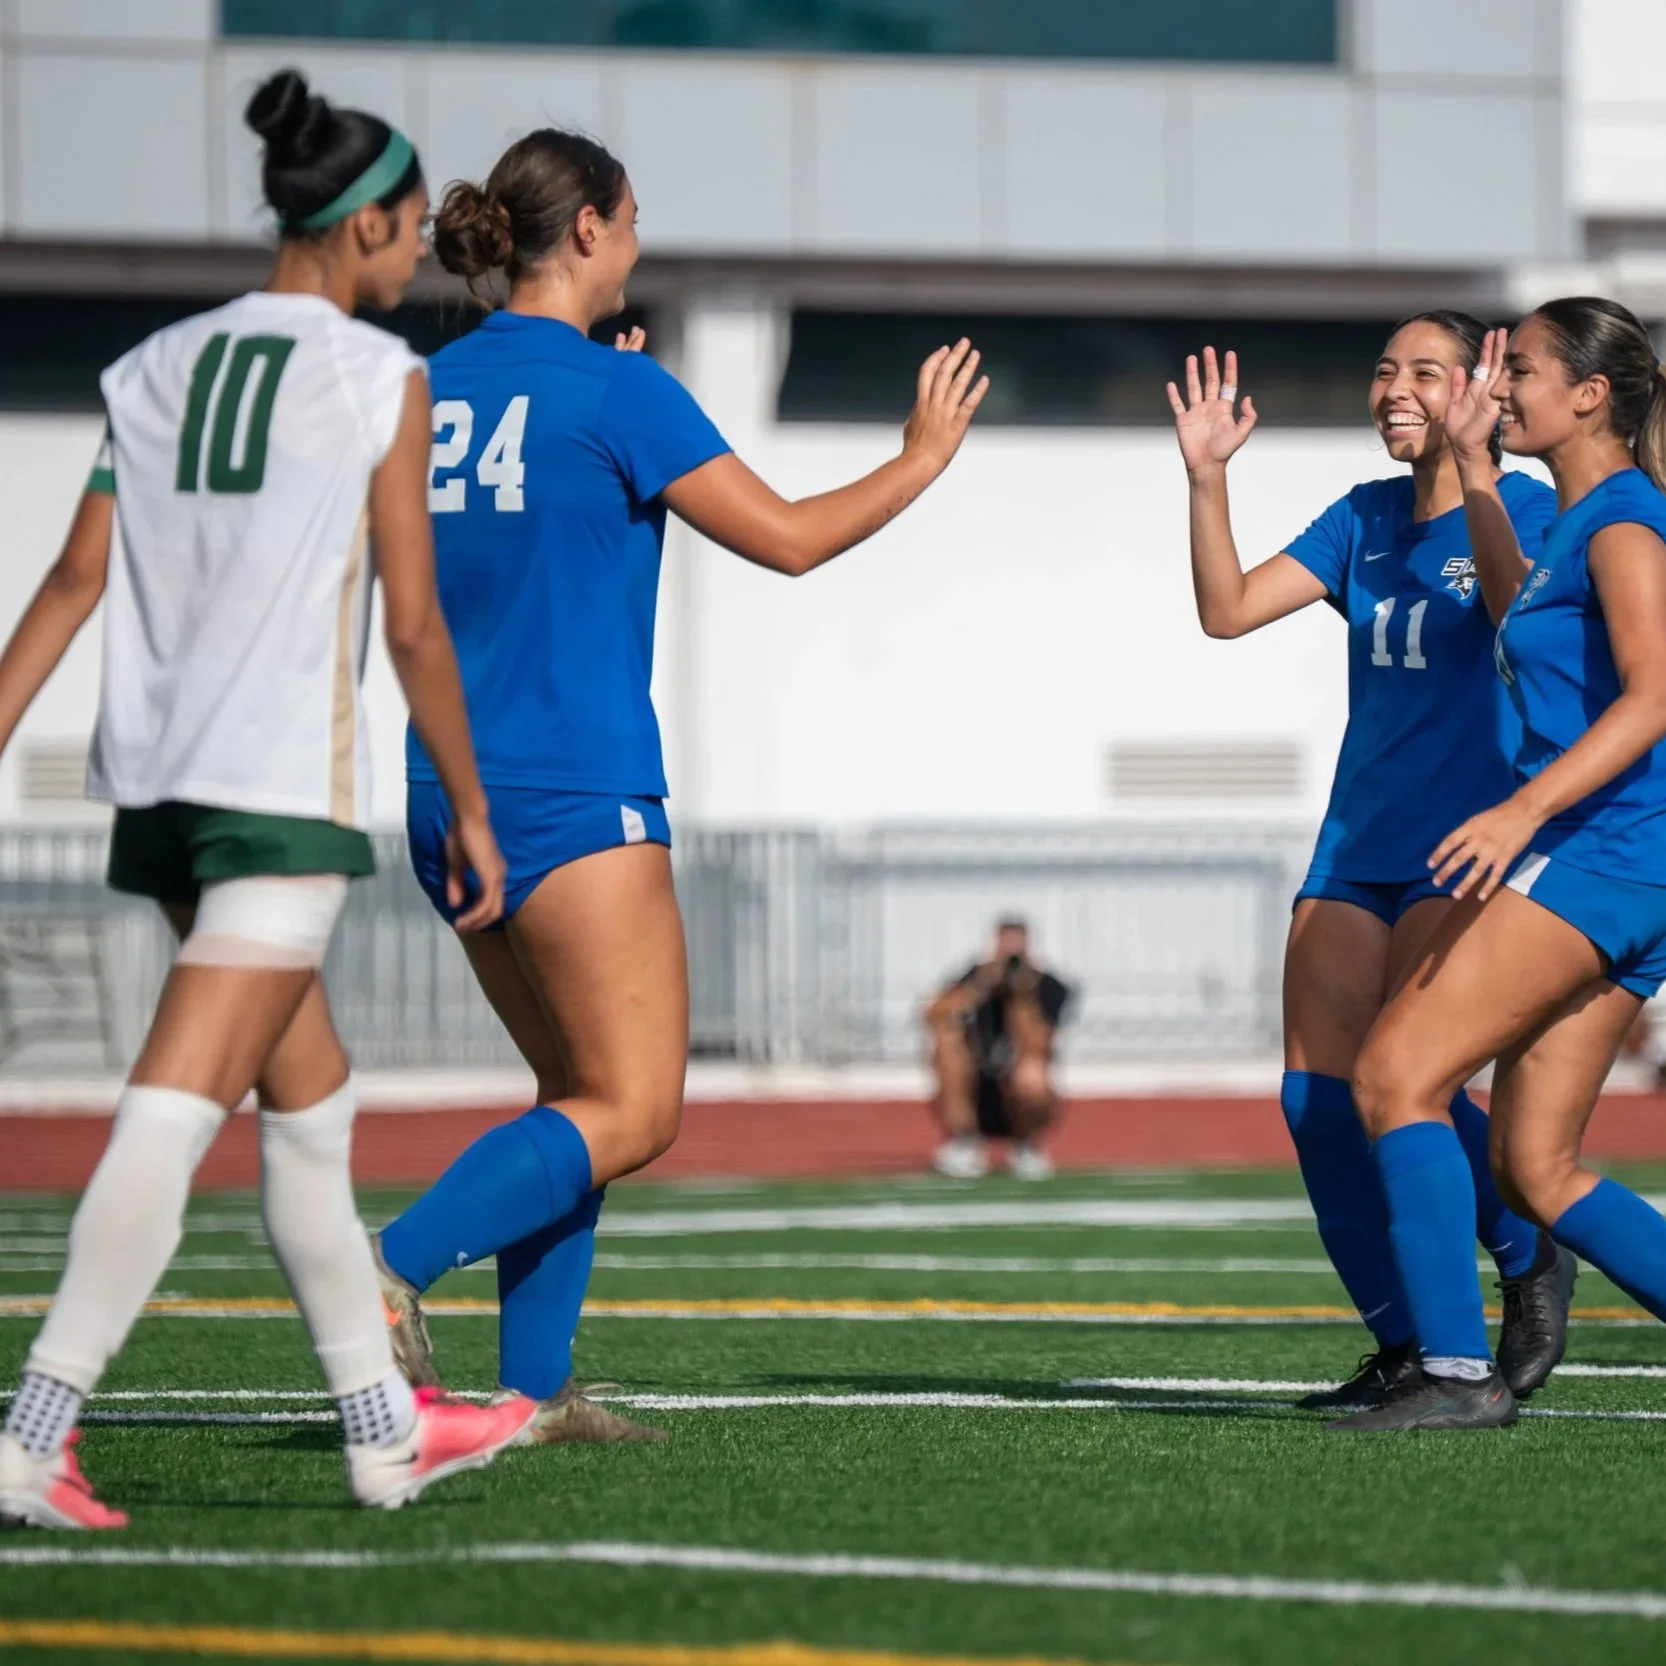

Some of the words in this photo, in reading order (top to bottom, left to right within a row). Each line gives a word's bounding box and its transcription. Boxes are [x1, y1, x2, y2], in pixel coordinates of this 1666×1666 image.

[176, 333, 297, 493] 10
[429, 396, 529, 511] 24
[1371, 597, 1428, 669] 11
